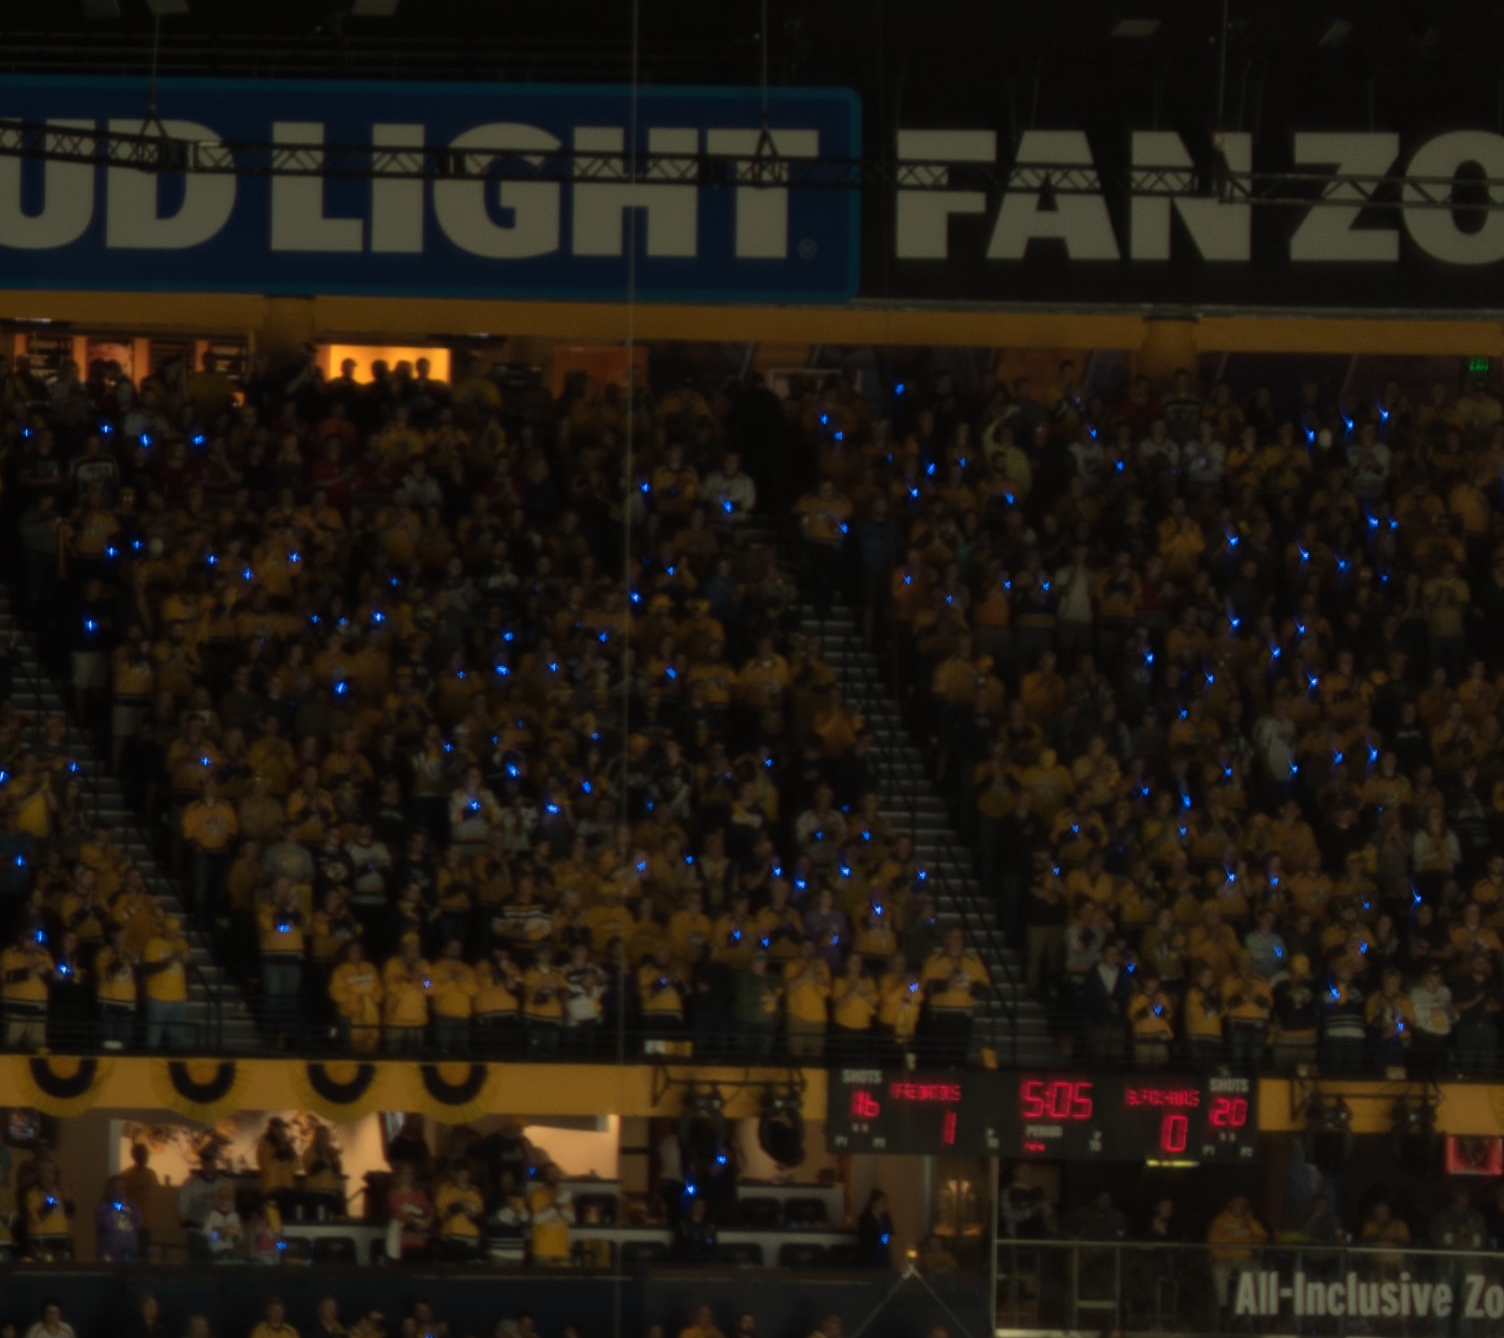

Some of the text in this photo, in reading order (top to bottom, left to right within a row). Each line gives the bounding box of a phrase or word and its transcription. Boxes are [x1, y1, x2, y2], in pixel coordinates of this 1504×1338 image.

[269, 124, 821, 262] LIGHT
[895, 130, 1252, 261] FAN
[841, 1069, 883, 1085] SHOTS
[1209, 1078, 1250, 1093] SHOTS
[1020, 1081, 1094, 1119] 5:05
[1210, 1098, 1248, 1126] 20
[1025, 1125, 1063, 1139] PERIOD
[1163, 1115, 1188, 1152] 0
[1234, 1271, 1450, 1318] All-Inclusive
